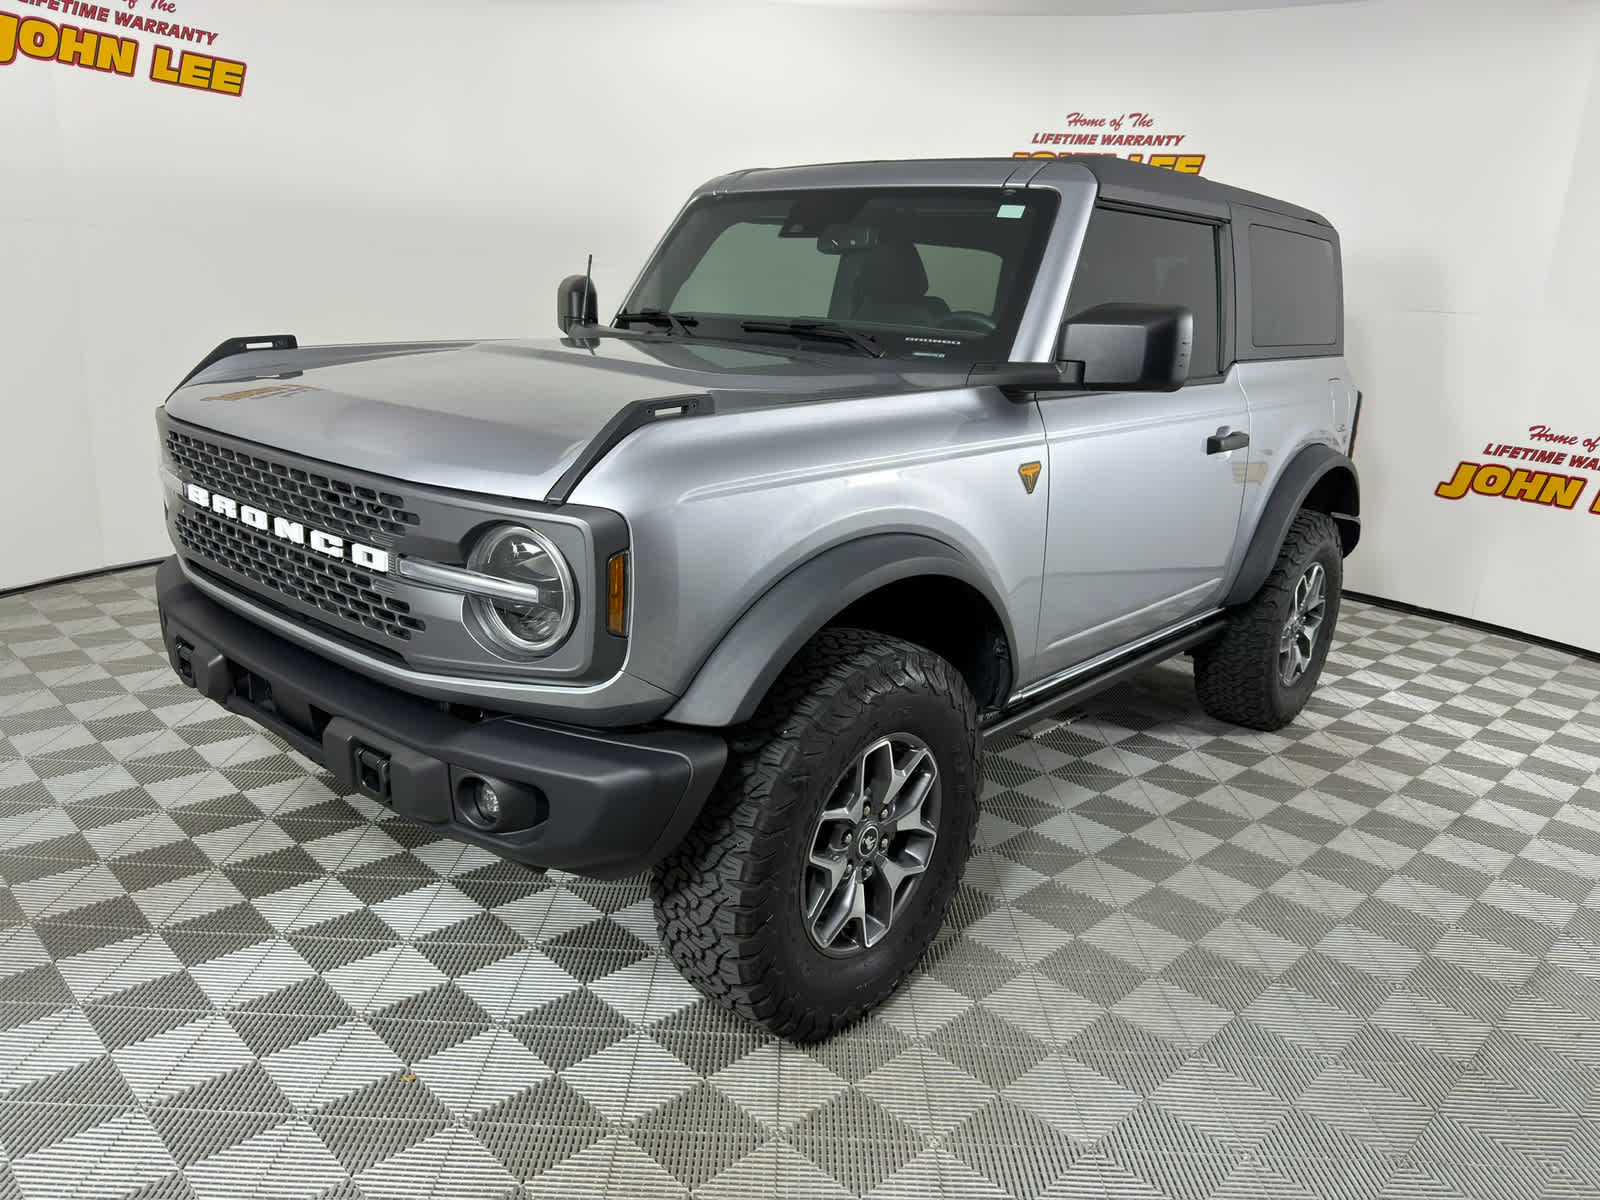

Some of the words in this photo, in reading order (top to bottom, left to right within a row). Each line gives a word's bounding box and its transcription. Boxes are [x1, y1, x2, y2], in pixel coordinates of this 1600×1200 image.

[18, 0, 110, 23] FETIME
[115, 11, 218, 45] WARRANTY
[150, 44, 247, 97] LEE
[1066, 112, 1106, 127] Home
[1109, 114, 1124, 131] of
[1129, 113, 1153, 128] The
[1032, 133, 1097, 145] LIFETIME
[1101, 134, 1185, 147] WARRANTY
[1483, 443, 1568, 465] LIFETIME
[1569, 454, 1600, 471] WA
[1529, 425, 1578, 446] Home
[1582, 436, 1600, 453] of
[1434, 460, 1588, 510] JOHN
[187, 483, 389, 573] BRONCO
